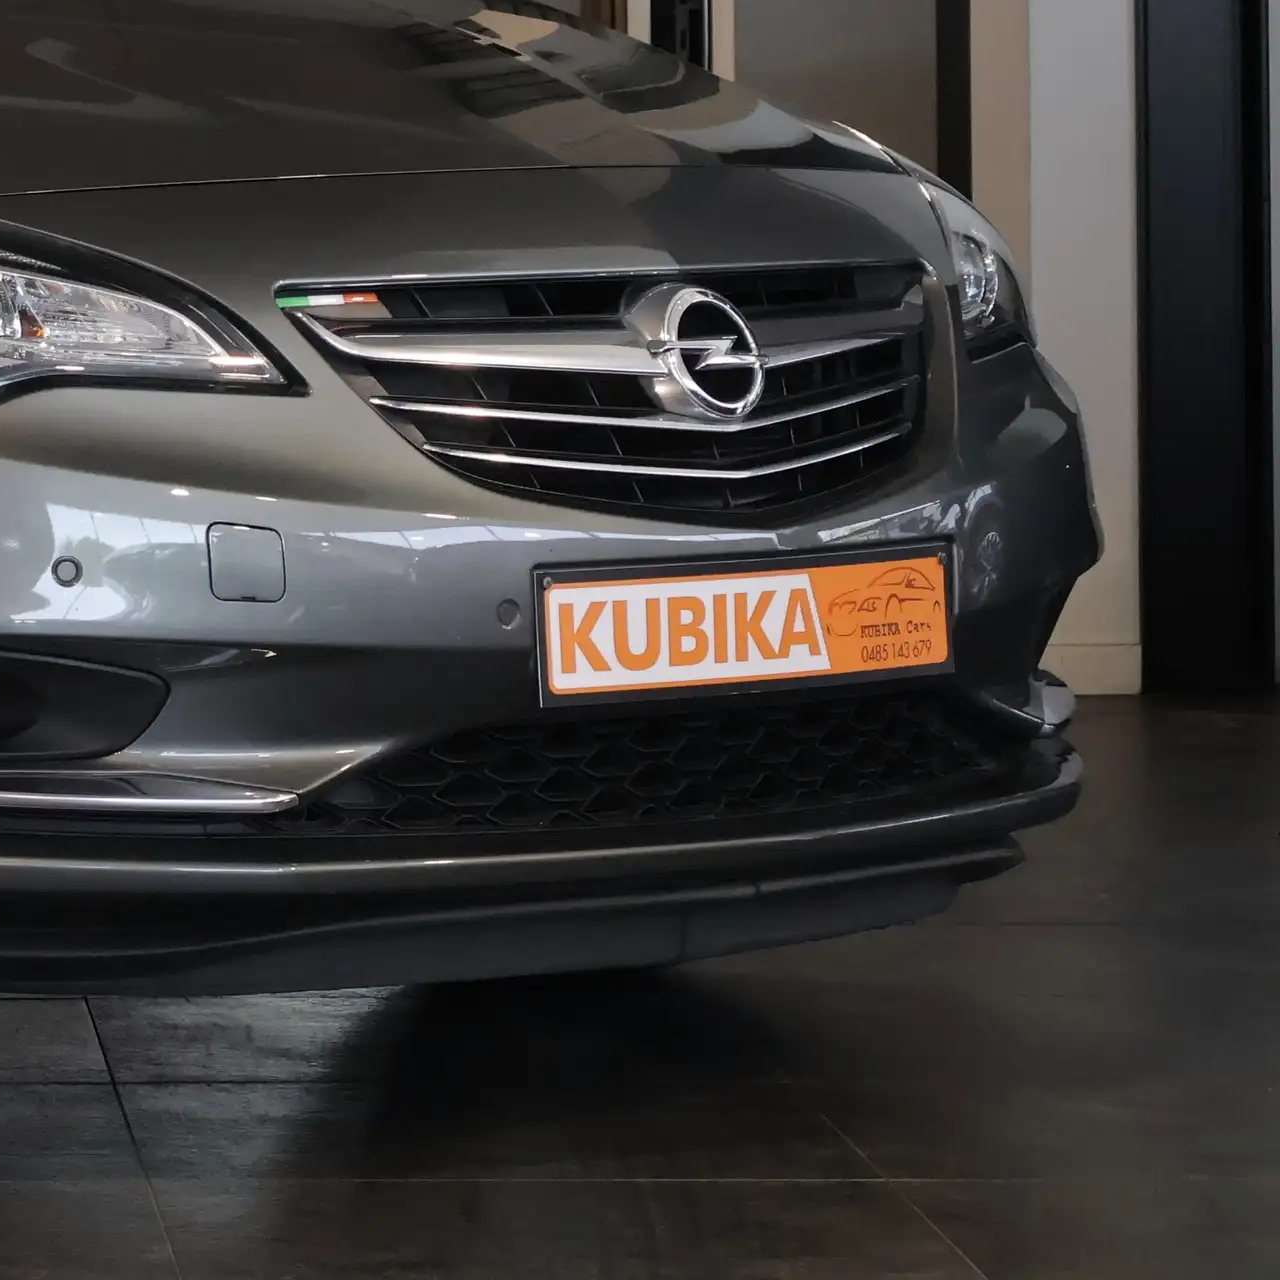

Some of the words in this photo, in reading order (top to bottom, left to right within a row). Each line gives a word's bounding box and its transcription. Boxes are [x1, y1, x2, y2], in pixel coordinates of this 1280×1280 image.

[558, 588, 821, 674] KUBIKA
[860, 622, 901, 639] KUBIKA
[906, 620, 932, 634] Cars
[861, 643, 889, 663] 0485
[892, 641, 910, 659] 143
[913, 639, 932, 658] 679
